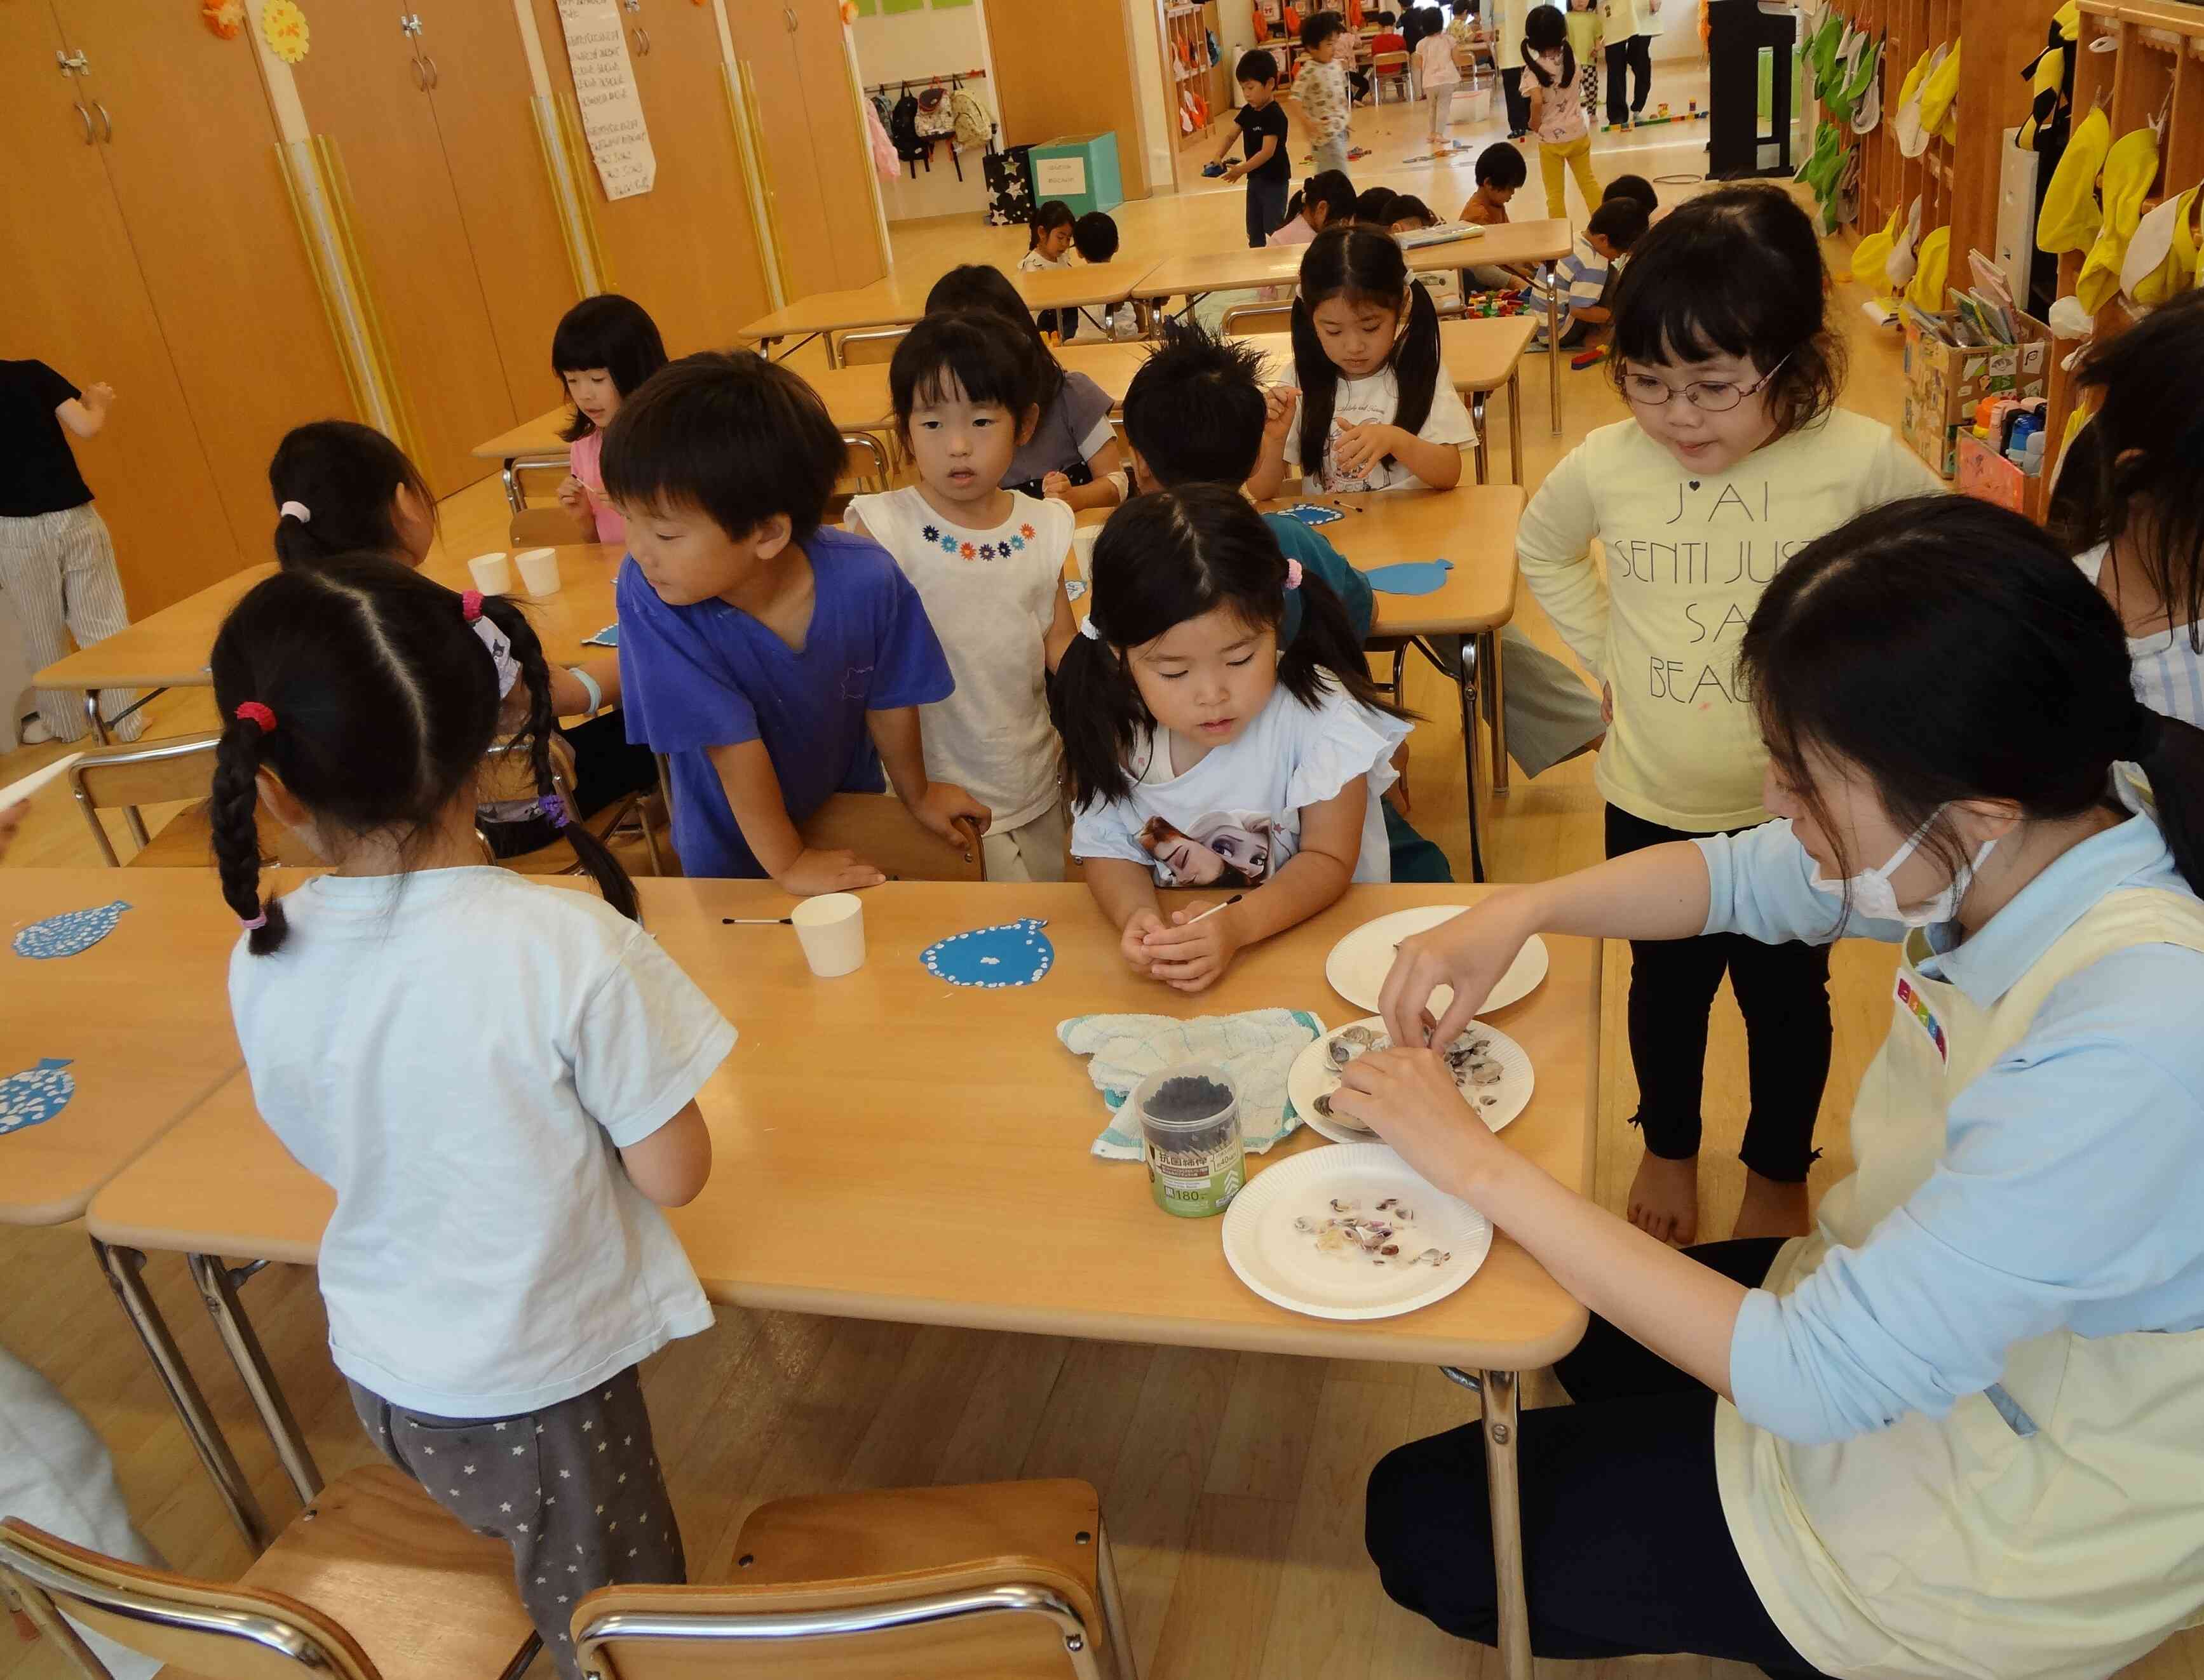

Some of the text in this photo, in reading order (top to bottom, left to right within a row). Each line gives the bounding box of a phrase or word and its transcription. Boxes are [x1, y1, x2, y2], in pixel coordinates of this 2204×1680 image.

[1615, 540, 1815, 584] SENTI JUS
[1686, 603, 1749, 643] SA
